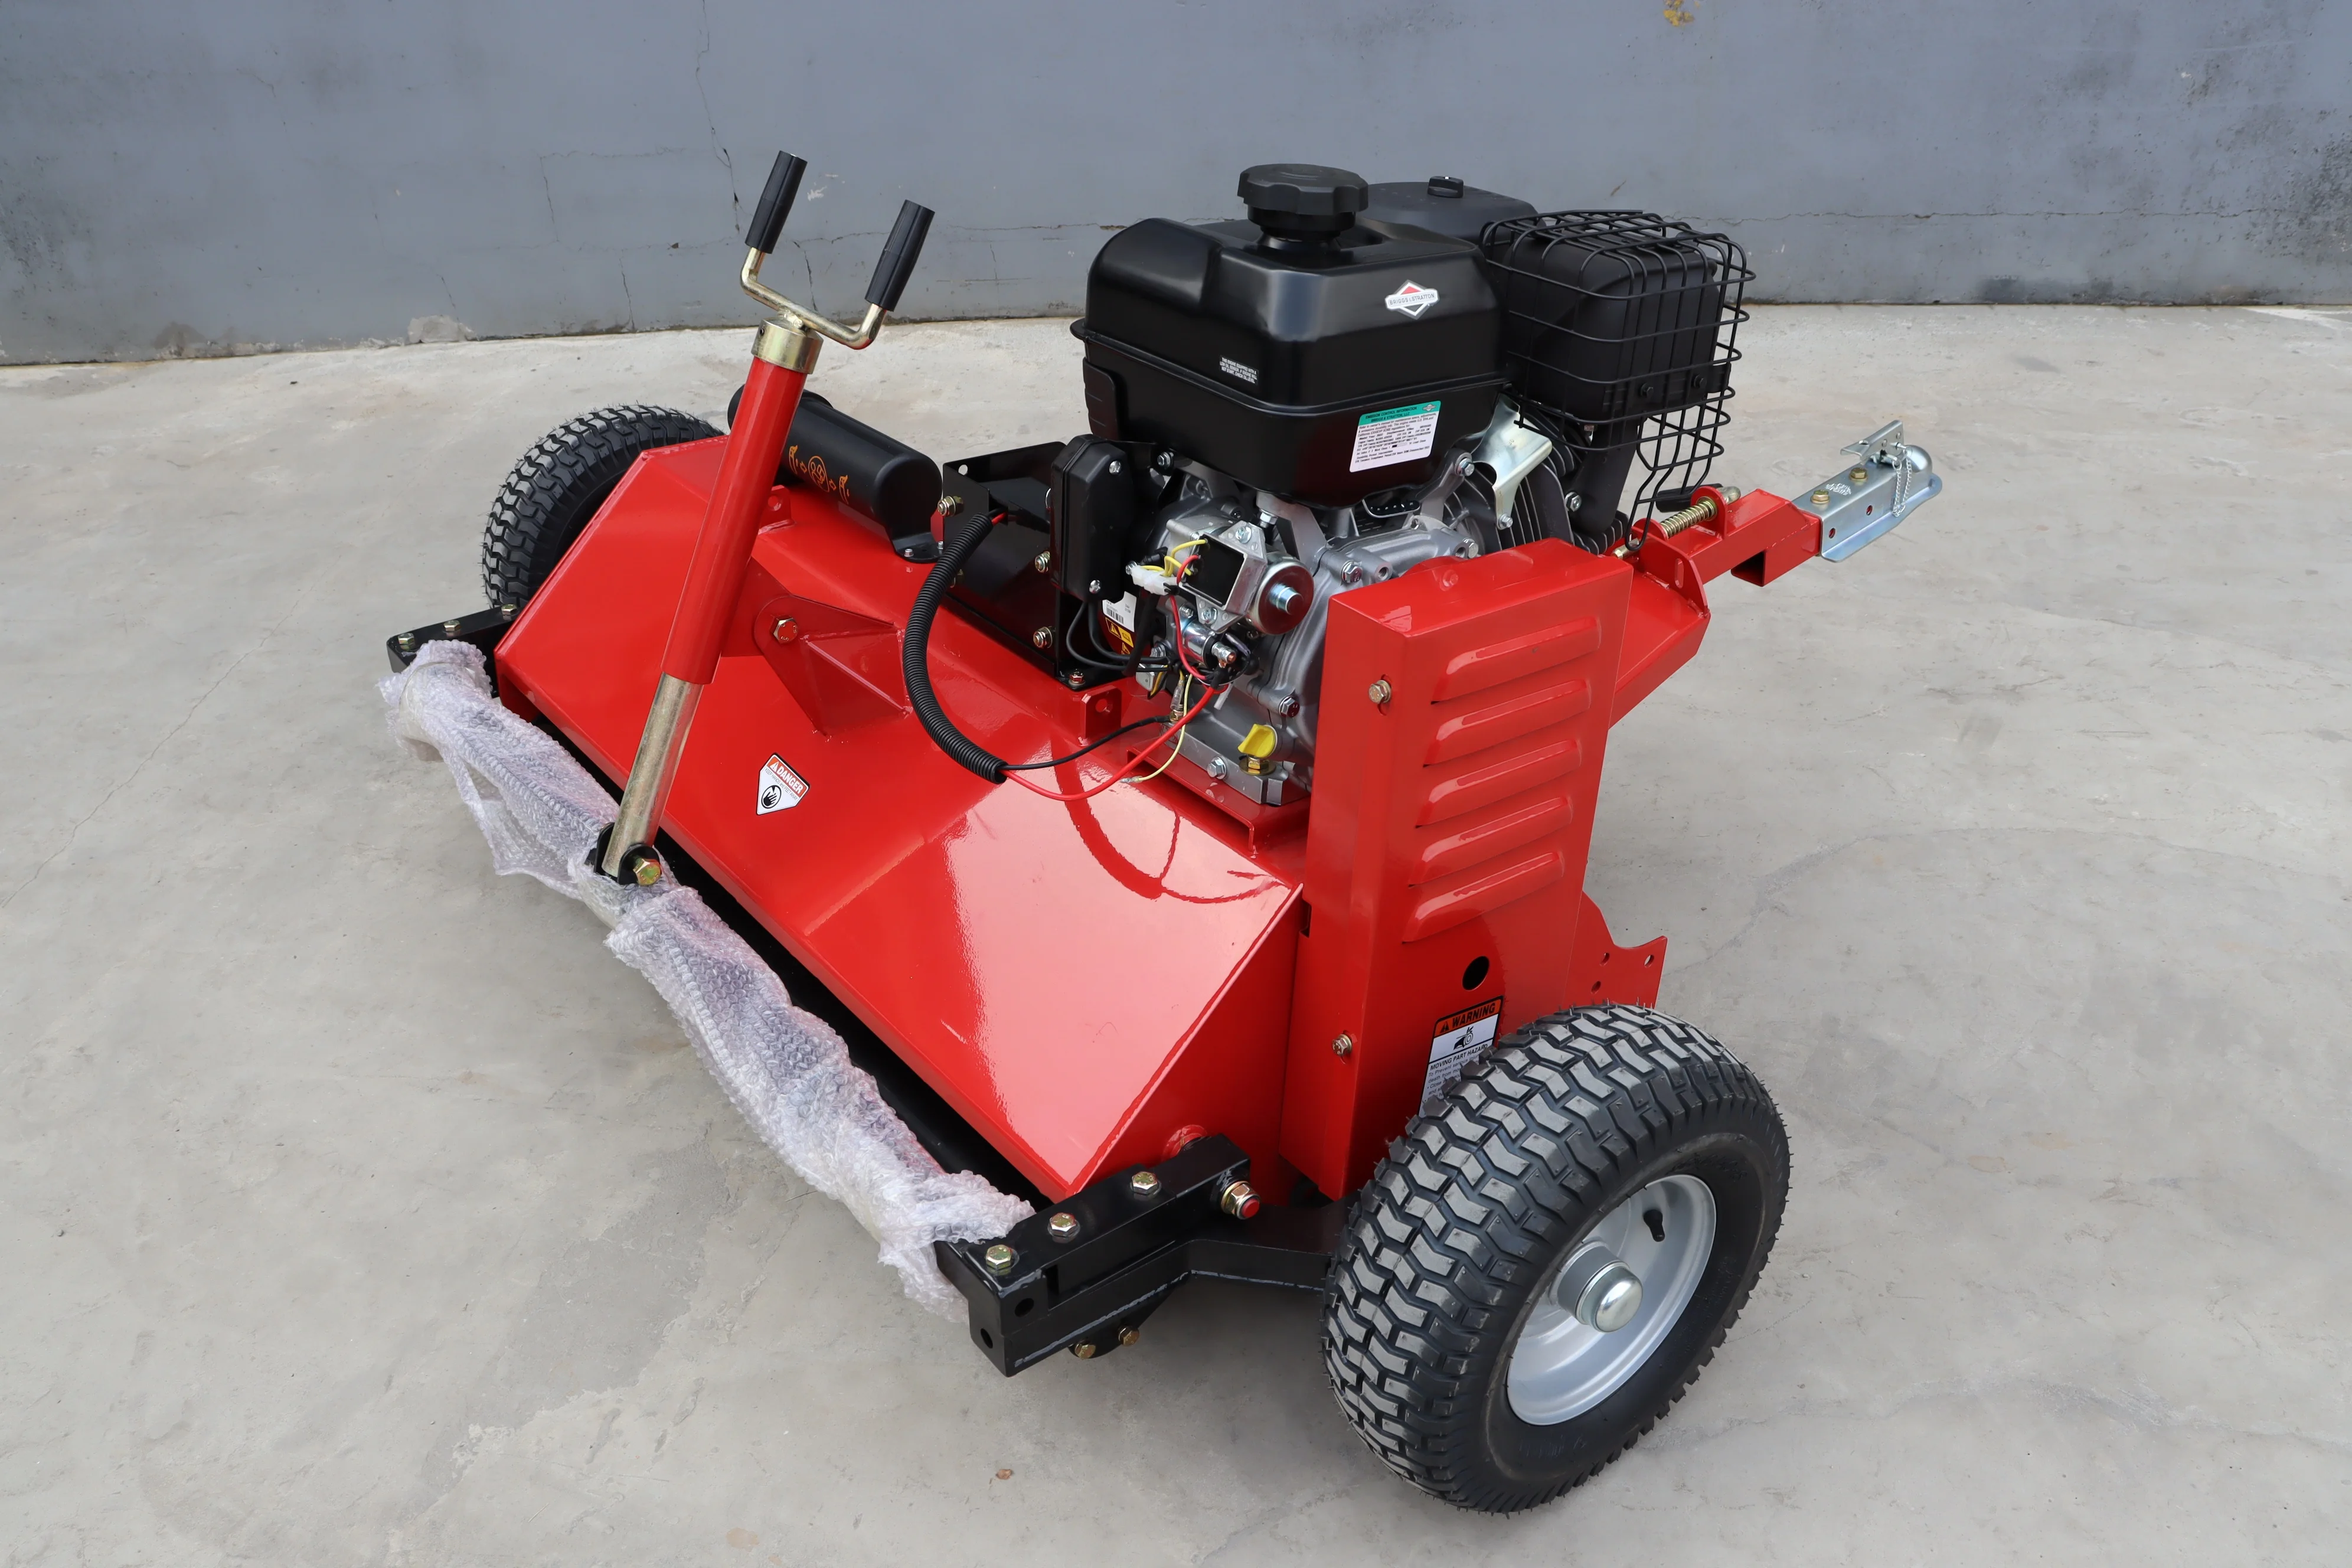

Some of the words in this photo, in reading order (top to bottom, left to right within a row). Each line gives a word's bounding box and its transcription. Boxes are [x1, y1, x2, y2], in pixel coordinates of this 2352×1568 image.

[1412, 293, 1435, 301] STRATTON
[1227, 359, 1236, 367] ENGINE
[771, 773, 780, 784] HANDS
[776, 765, 803, 794] DANGER
[1452, 1002, 1497, 1028] WARNING
[1430, 1058, 1452, 1071] MOVING
[1453, 1051, 1467, 1062] PART
[1467, 1043, 1488, 1057] HAZARD
[1435, 1064, 1452, 1074] Prevent
